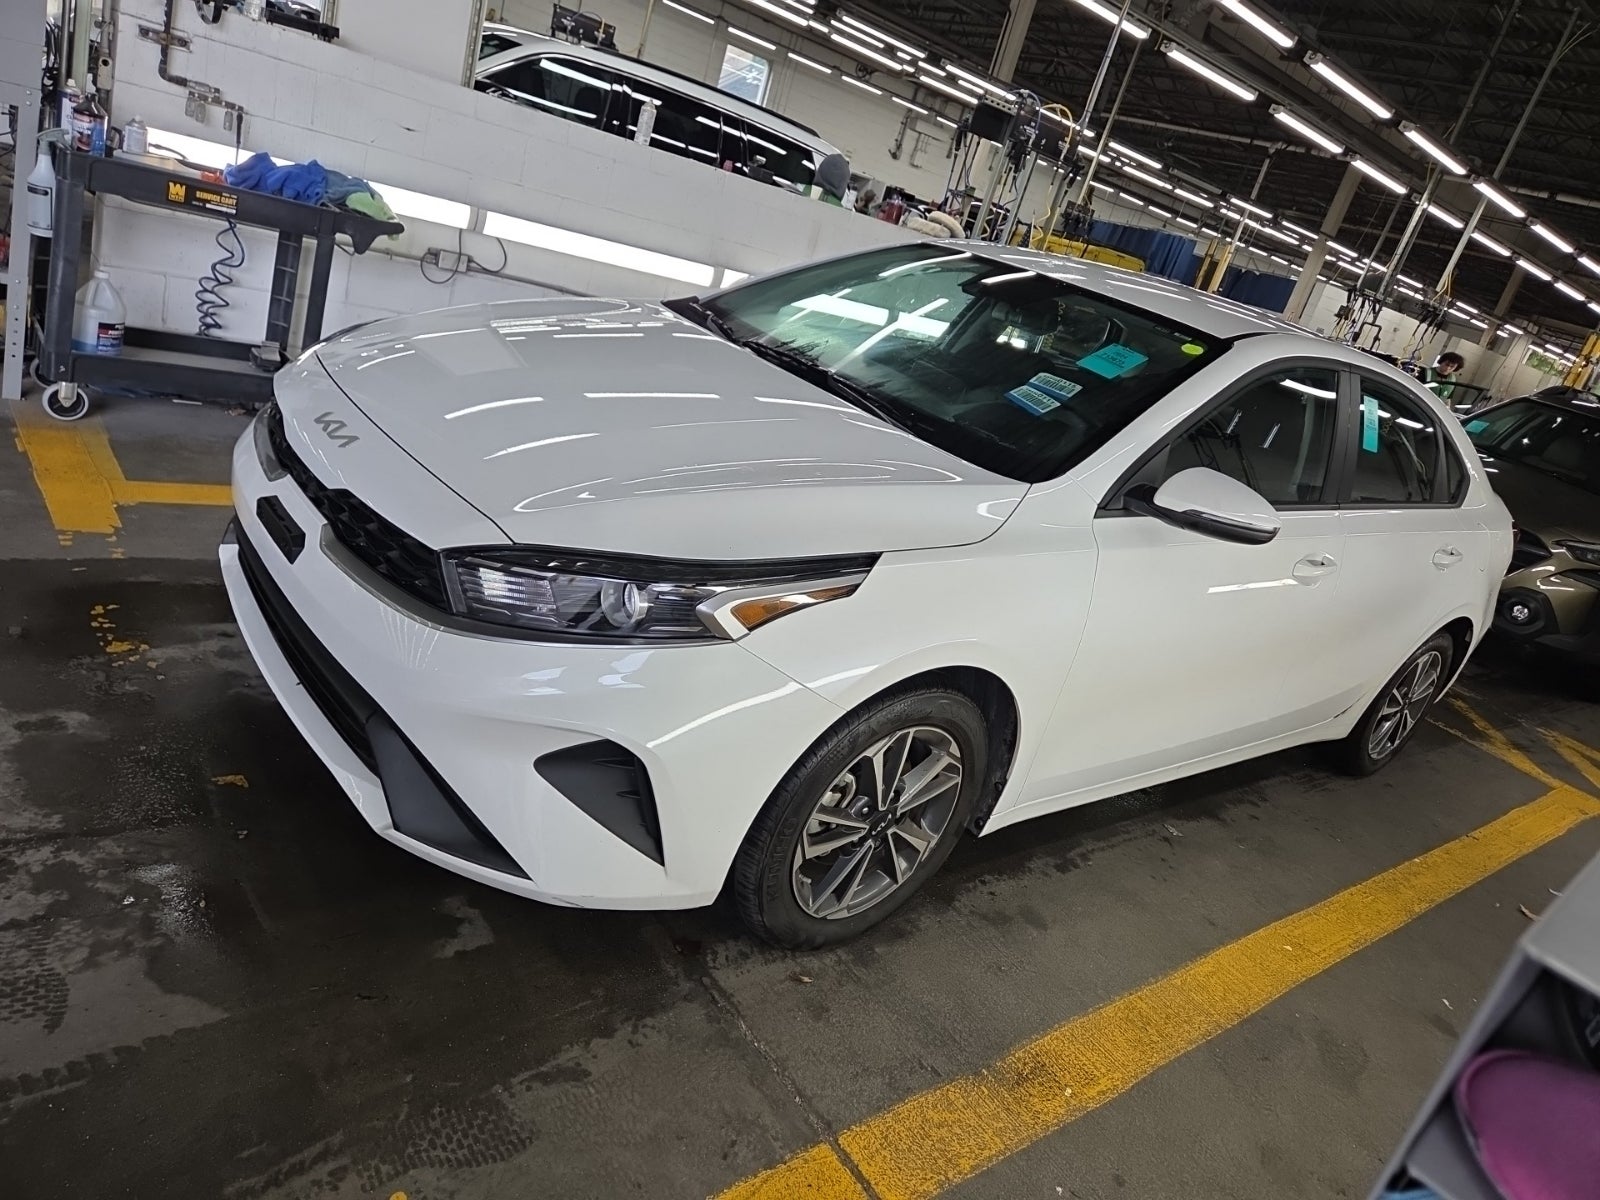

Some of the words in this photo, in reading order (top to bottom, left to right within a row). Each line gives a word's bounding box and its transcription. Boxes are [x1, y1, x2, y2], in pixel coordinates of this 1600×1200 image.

[196, 191, 221, 201] SERVICE
[221, 197, 237, 206] CART
[313, 411, 360, 448] KIA
